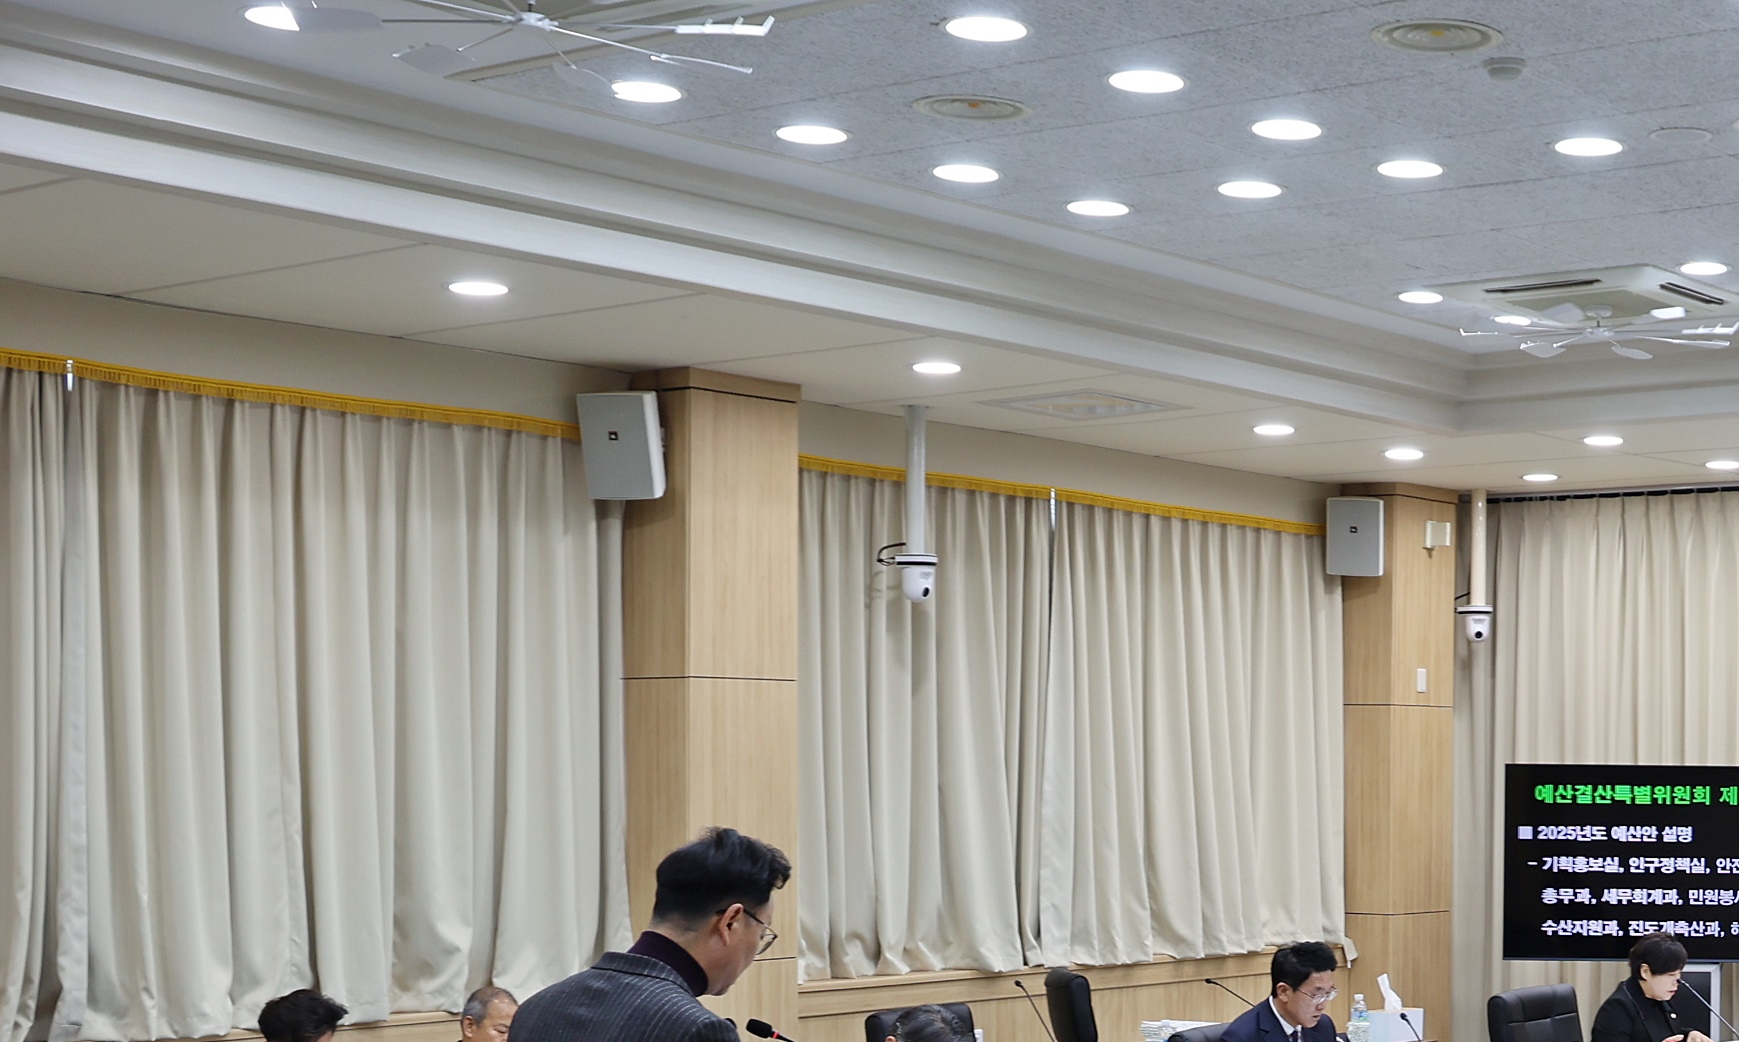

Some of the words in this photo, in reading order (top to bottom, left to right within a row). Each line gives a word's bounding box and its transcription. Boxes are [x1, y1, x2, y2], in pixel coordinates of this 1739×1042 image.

[1534, 784, 1711, 805] 예산결산특별위원회
[1537, 826, 1607, 842] 2025년도
[1611, 825, 1658, 842] 예산안
[1662, 826, 1694, 843] 설명
[1542, 856, 1625, 874] 기획홍보실,
[1629, 857, 1711, 875] 인구정책실,
[1541, 888, 1597, 905] 총무과,
[1601, 888, 1683, 906] 세무회계과,
[1541, 919, 1624, 937] 수산지원과,
